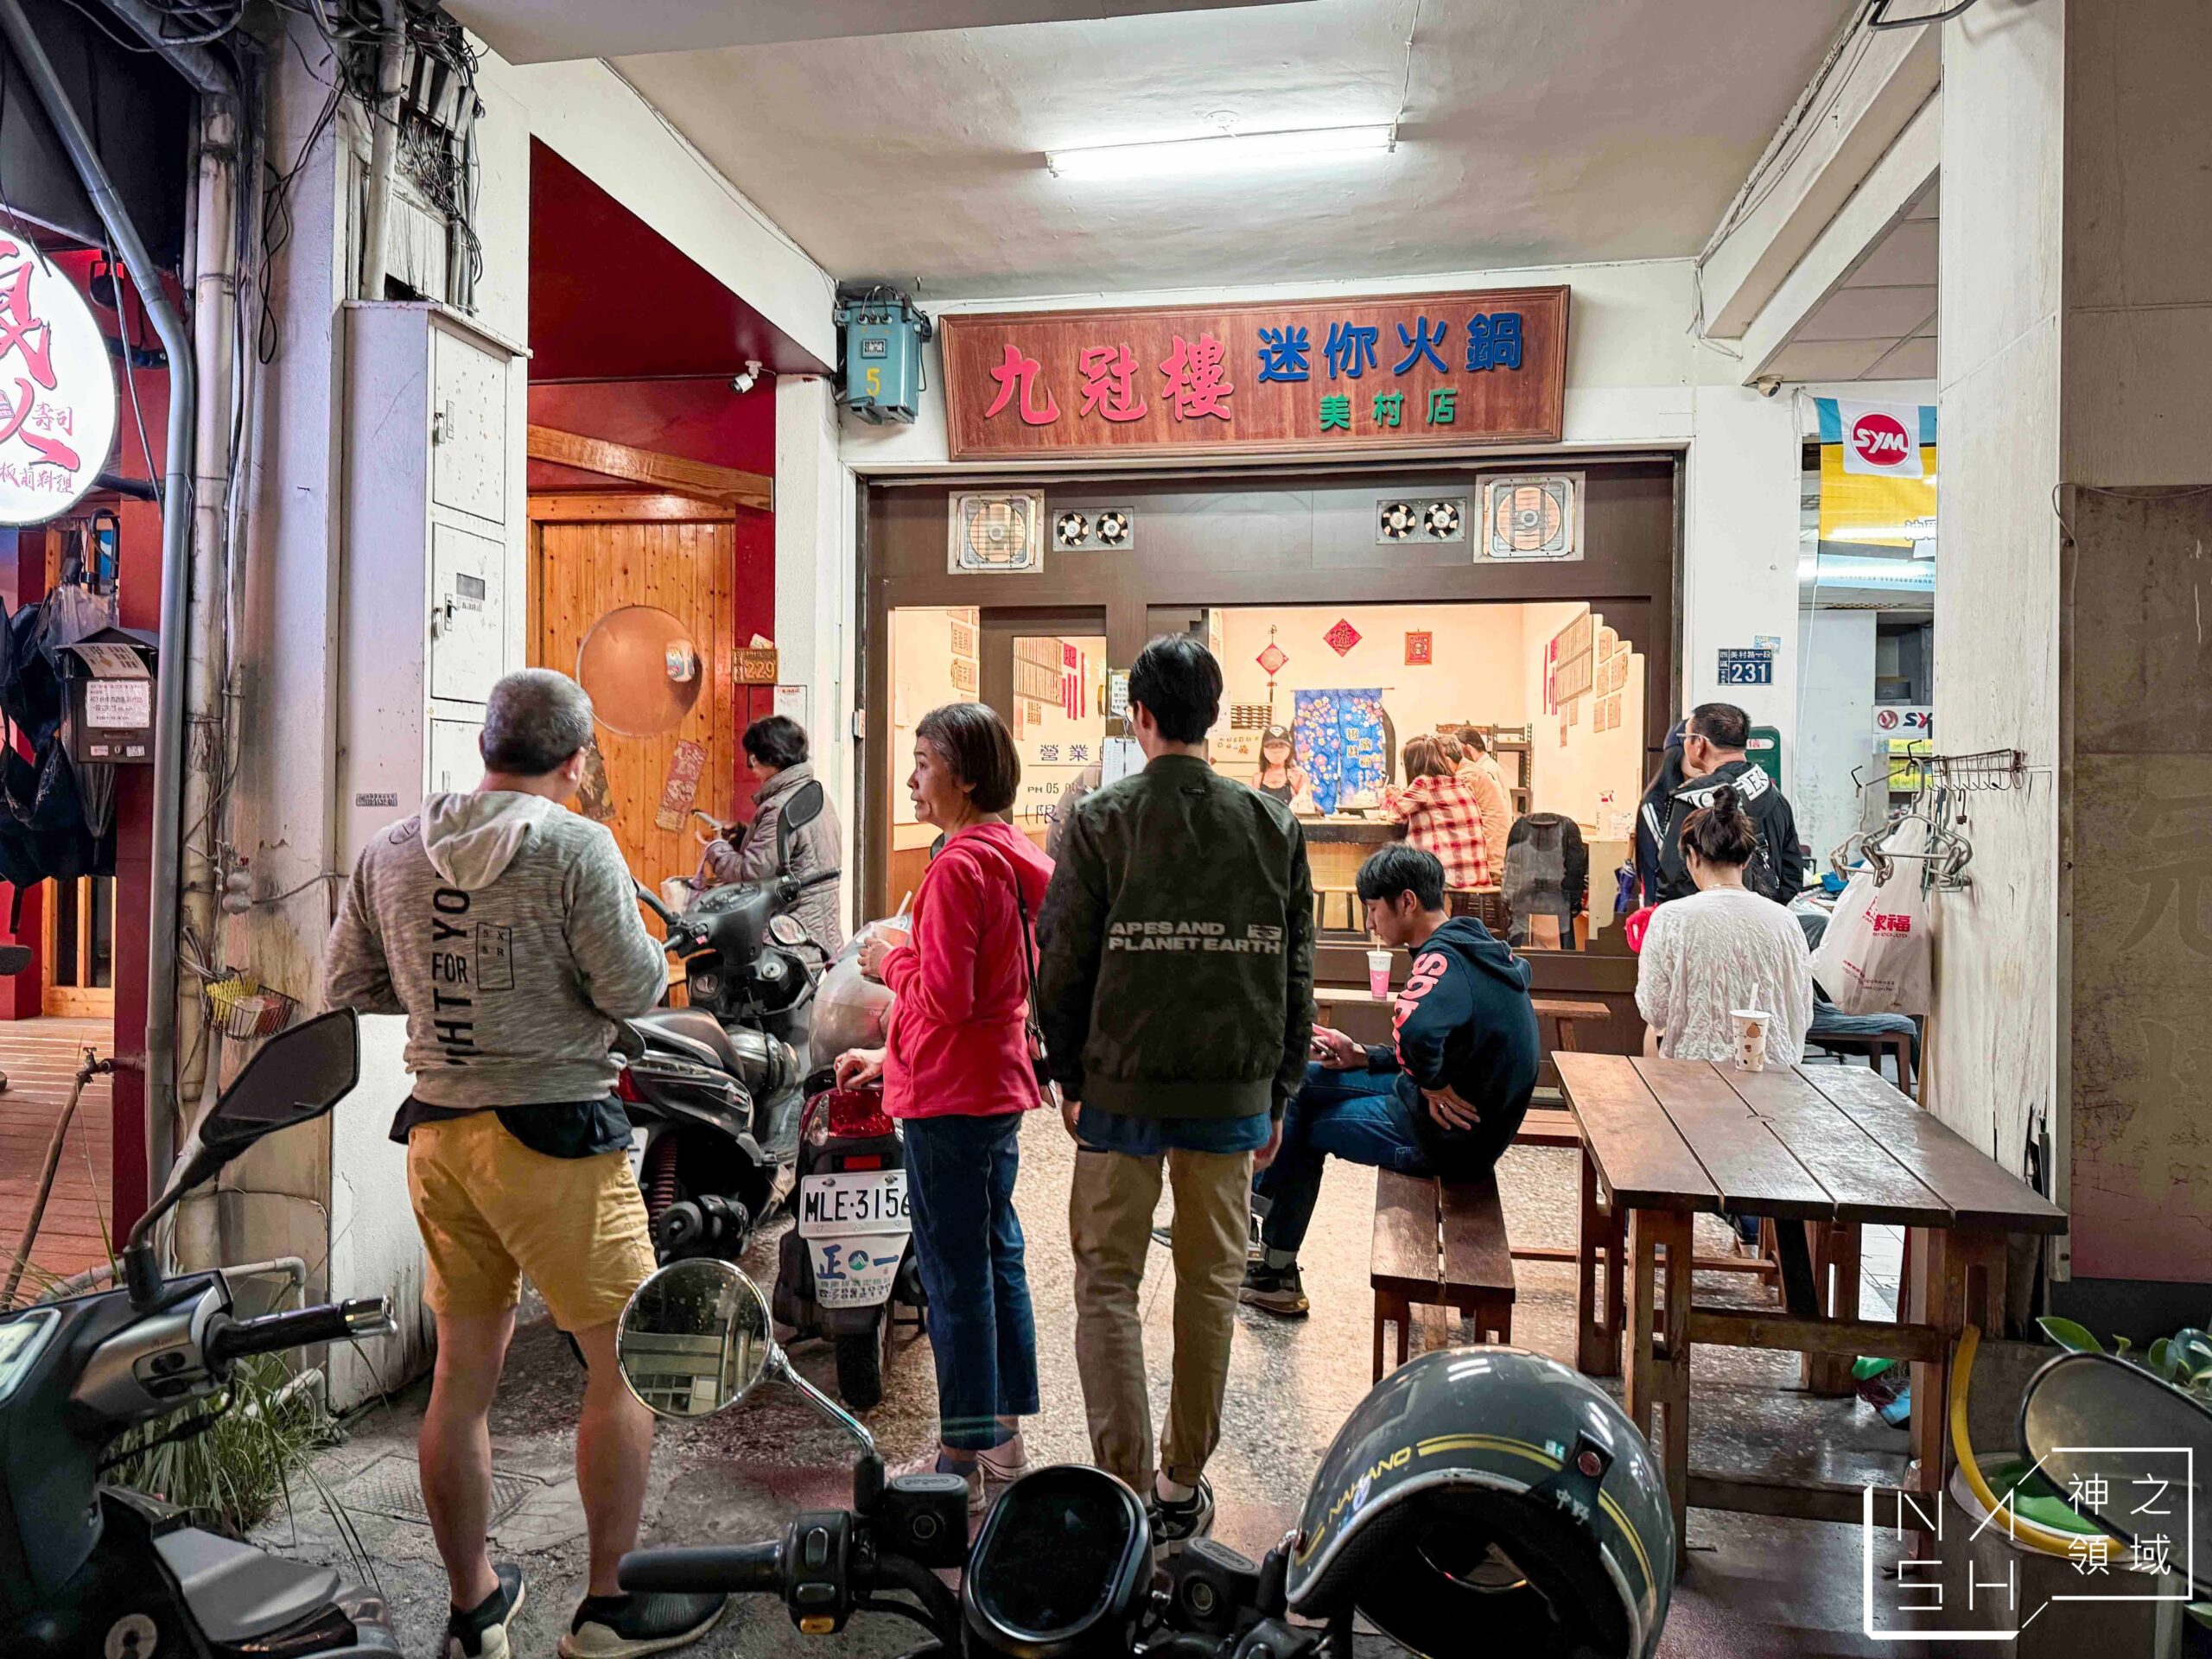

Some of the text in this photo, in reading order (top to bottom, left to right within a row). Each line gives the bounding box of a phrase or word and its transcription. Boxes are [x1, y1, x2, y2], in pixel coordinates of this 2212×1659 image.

[867, 367, 880, 397] 5
[985, 312, 1522, 426] 九冠樓 迷你火鍋
[1319, 388, 1457, 431] 美村店
[1853, 428, 1909, 454] SYM
[745, 660, 775, 679] 229
[1732, 663, 1766, 682] 231
[1110, 921, 1225, 935] APES AND
[1109, 936, 1281, 955] PLANET EARTH
[433, 952, 469, 983] FOR
